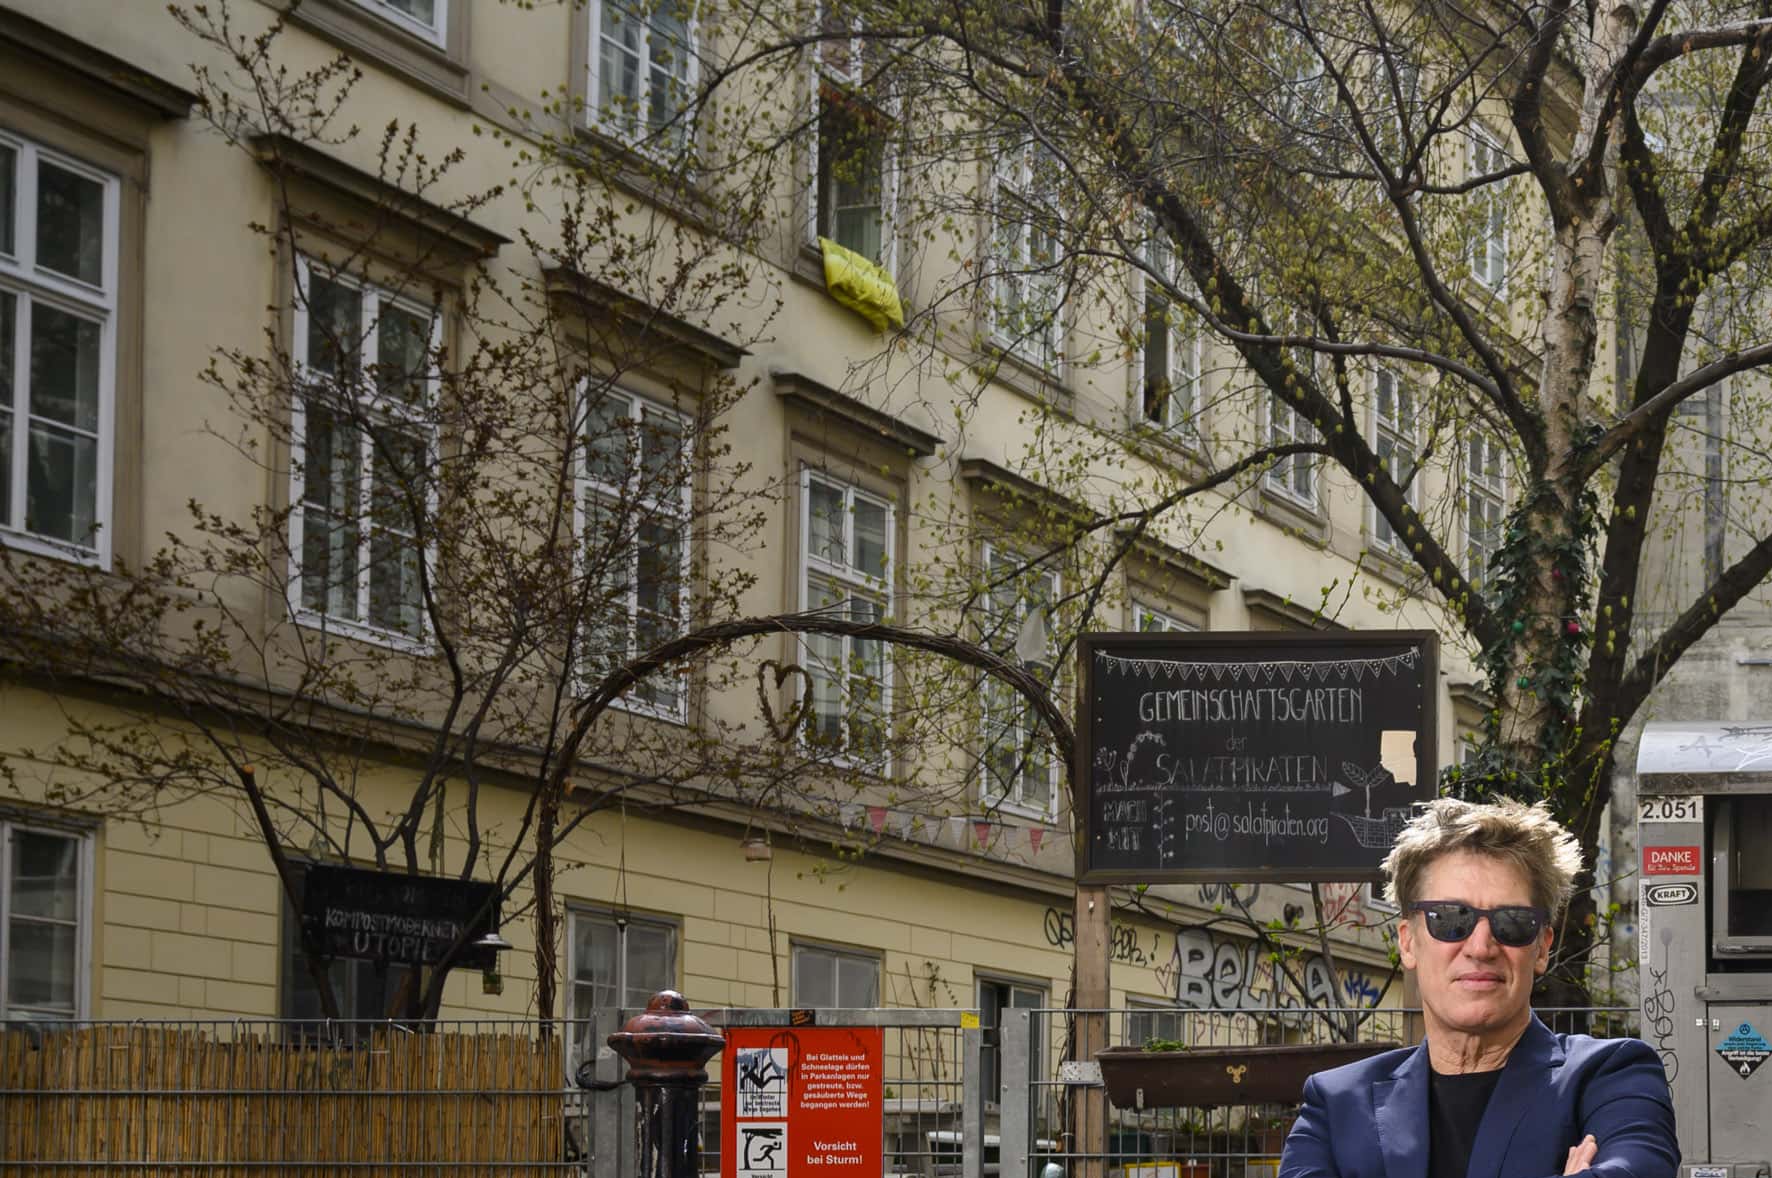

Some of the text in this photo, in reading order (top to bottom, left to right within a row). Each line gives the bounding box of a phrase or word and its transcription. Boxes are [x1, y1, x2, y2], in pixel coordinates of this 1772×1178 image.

[1139, 688, 1363, 723] GEMEINSCHAFTSGARTEN
[1641, 801, 1698, 820] 2.051
[1651, 851, 1692, 864] DANKE
[1657, 889, 1687, 900] KRAFT
[806, 1053, 865, 1061] Bei Glatteis und
[801, 1063, 871, 1072] Schneelage dürfen
[810, 1072, 856, 1081] Parkanlagen
[803, 1091, 868, 1101] gesäuberte Wege
[800, 1101, 870, 1111] begangen werden!
[814, 1141, 857, 1151] Vorsicht
[807, 1154, 863, 1165] bei Sturm!
